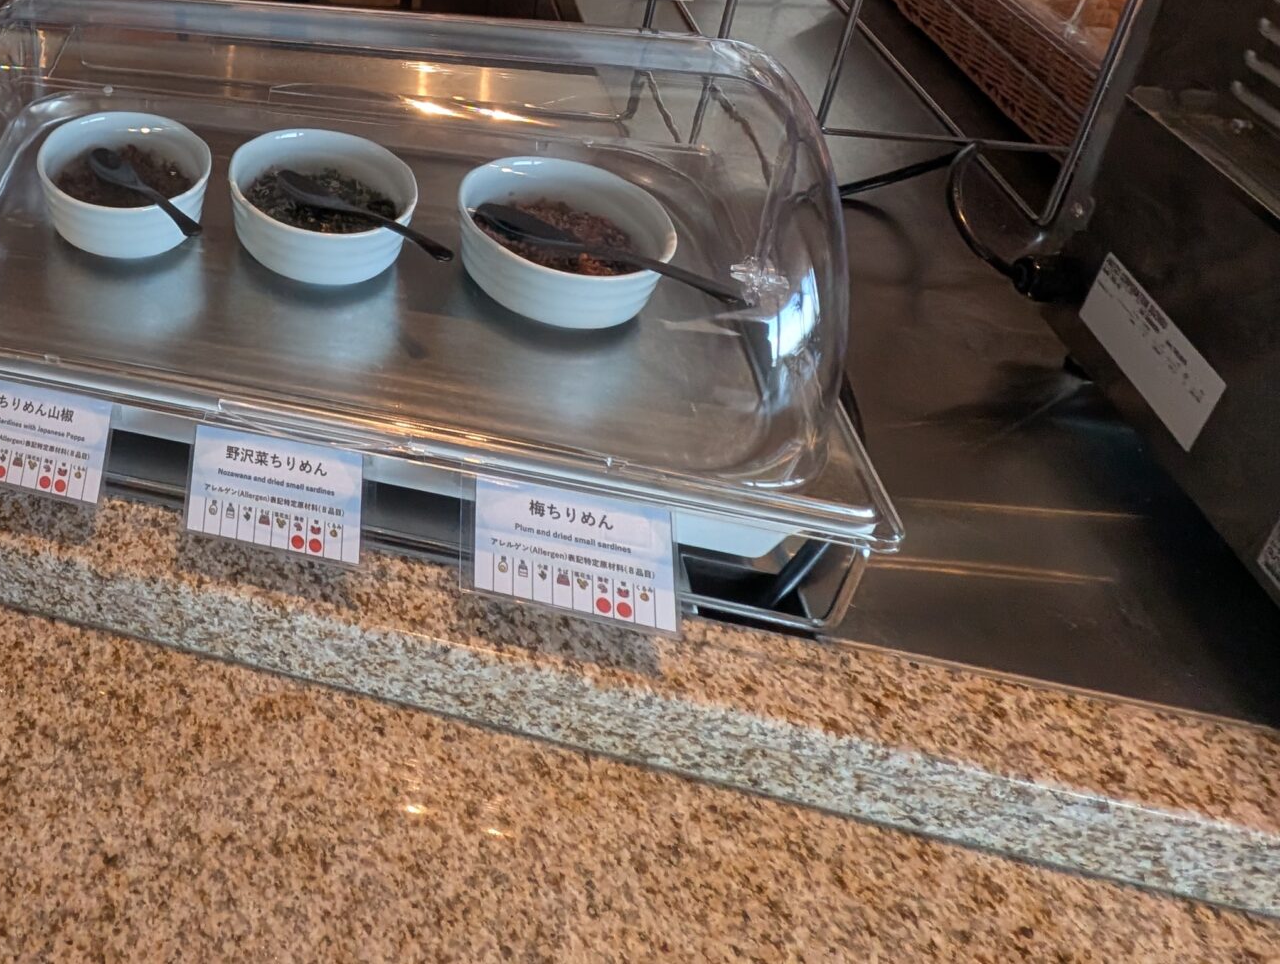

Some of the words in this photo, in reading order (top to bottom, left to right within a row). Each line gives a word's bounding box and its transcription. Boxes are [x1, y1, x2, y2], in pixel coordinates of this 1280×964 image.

[23, 422, 36, 432] with
[37, 425, 64, 438] Japanese
[225, 444, 328, 477] 野沢菜ちりめん
[218, 467, 252, 481] Nozawana
[253, 473, 266, 484] and
[267, 476, 284, 488] dried
[286, 480, 304, 491] small
[305, 483, 335, 496] sardines
[528, 499, 614, 531] 梅ちりめん
[514, 522, 534, 534] Plum
[536, 527, 550, 538] and
[552, 530, 572, 542] dried
[574, 536, 596, 547] small
[597, 540, 632, 554] sardines
